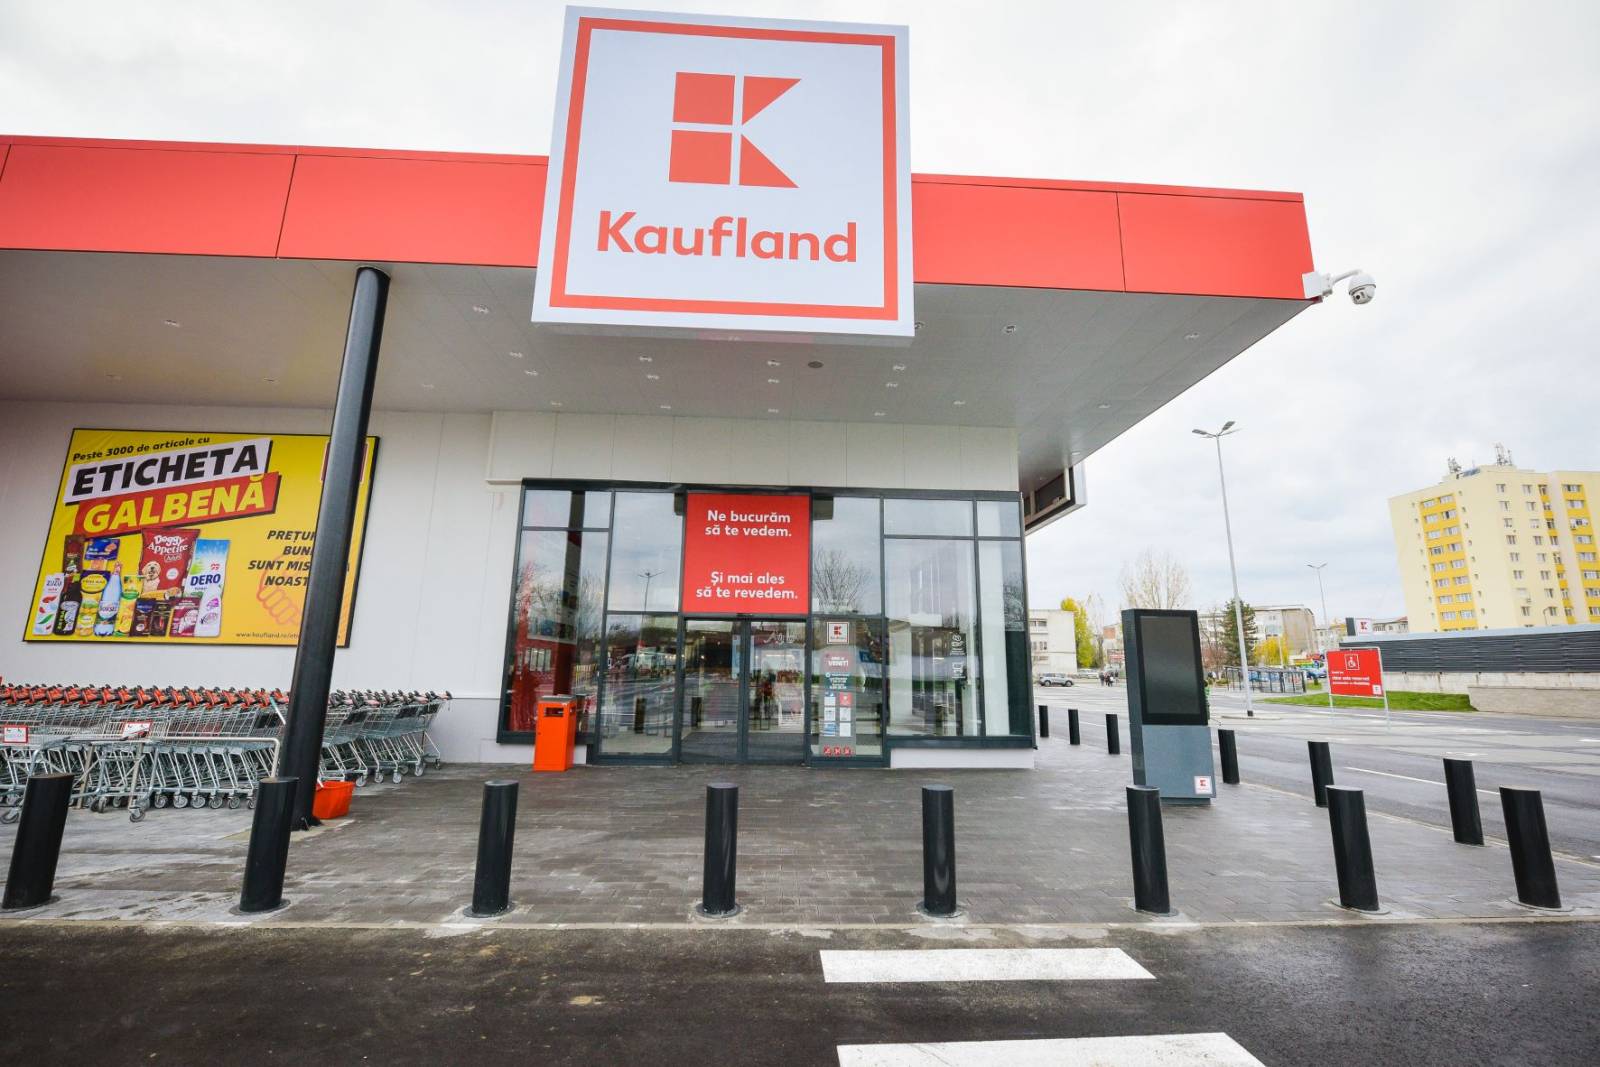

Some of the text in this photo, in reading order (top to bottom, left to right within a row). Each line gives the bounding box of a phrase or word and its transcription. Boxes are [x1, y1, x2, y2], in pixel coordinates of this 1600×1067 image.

[597, 210, 857, 263] Kaufland
[73, 451, 103, 461] Peste
[105, 445, 134, 456] 3000
[136, 444, 150, 452] de
[153, 437, 194, 450] articole
[72, 444, 259, 496] ETICHETA
[83, 474, 265, 533] GALBENĂ
[707, 510, 791, 523] Ne bucurăm
[267, 530, 317, 542] PREȚU
[705, 524, 792, 537] să te vedem.
[153, 535, 185, 546] Doggy
[147, 542, 188, 555] Appetite
[283, 546, 314, 556] BUN
[248, 560, 284, 570] SUNT
[190, 573, 221, 586] DERO
[264, 576, 309, 587] NOAST
[711, 571, 785, 586] Și mai ales
[696, 586, 798, 599] să te revedem.
